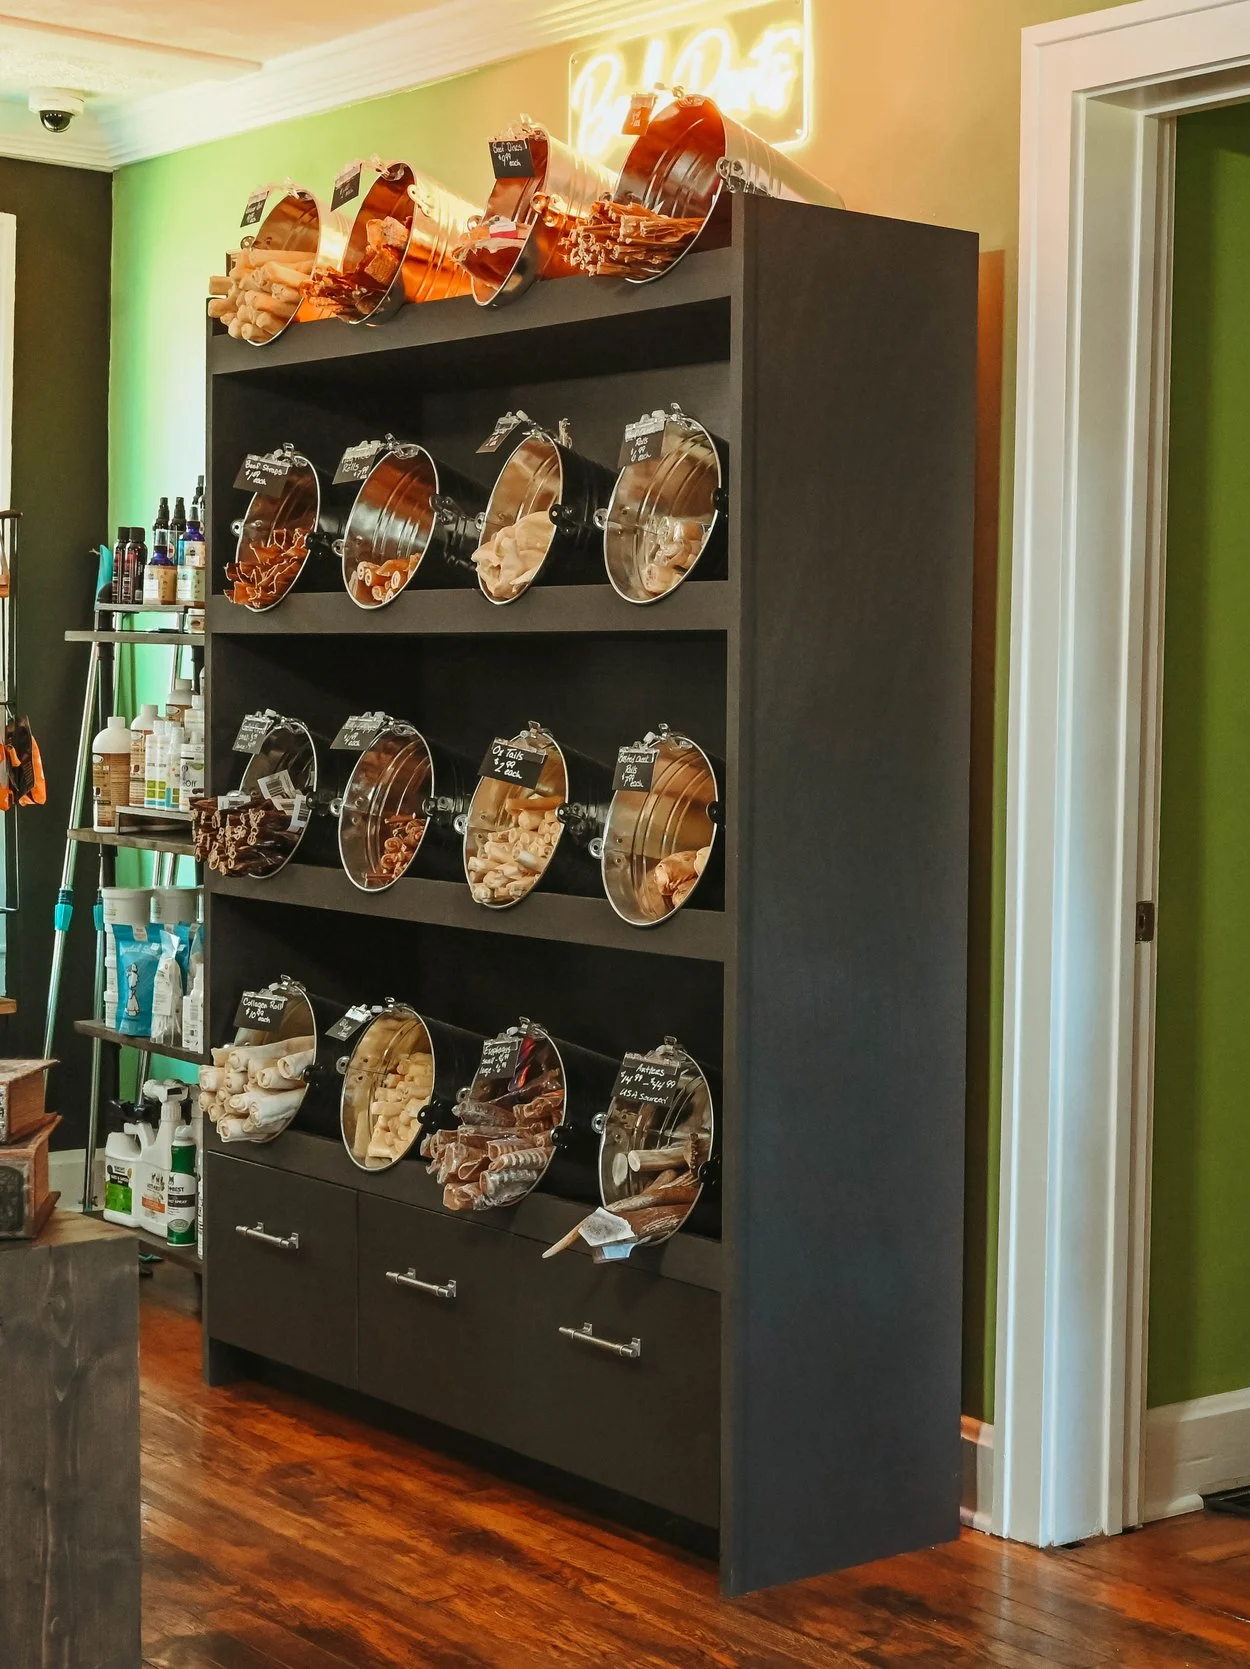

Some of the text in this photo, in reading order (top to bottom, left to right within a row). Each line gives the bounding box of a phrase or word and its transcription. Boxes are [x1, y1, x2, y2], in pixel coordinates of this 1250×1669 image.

[506, 748, 525, 761] Tails
[503, 768, 523, 779] each
[242, 998, 268, 1010] Collagen
[636, 1063, 665, 1077] Antlers
[619, 1087, 638, 1098] USA
